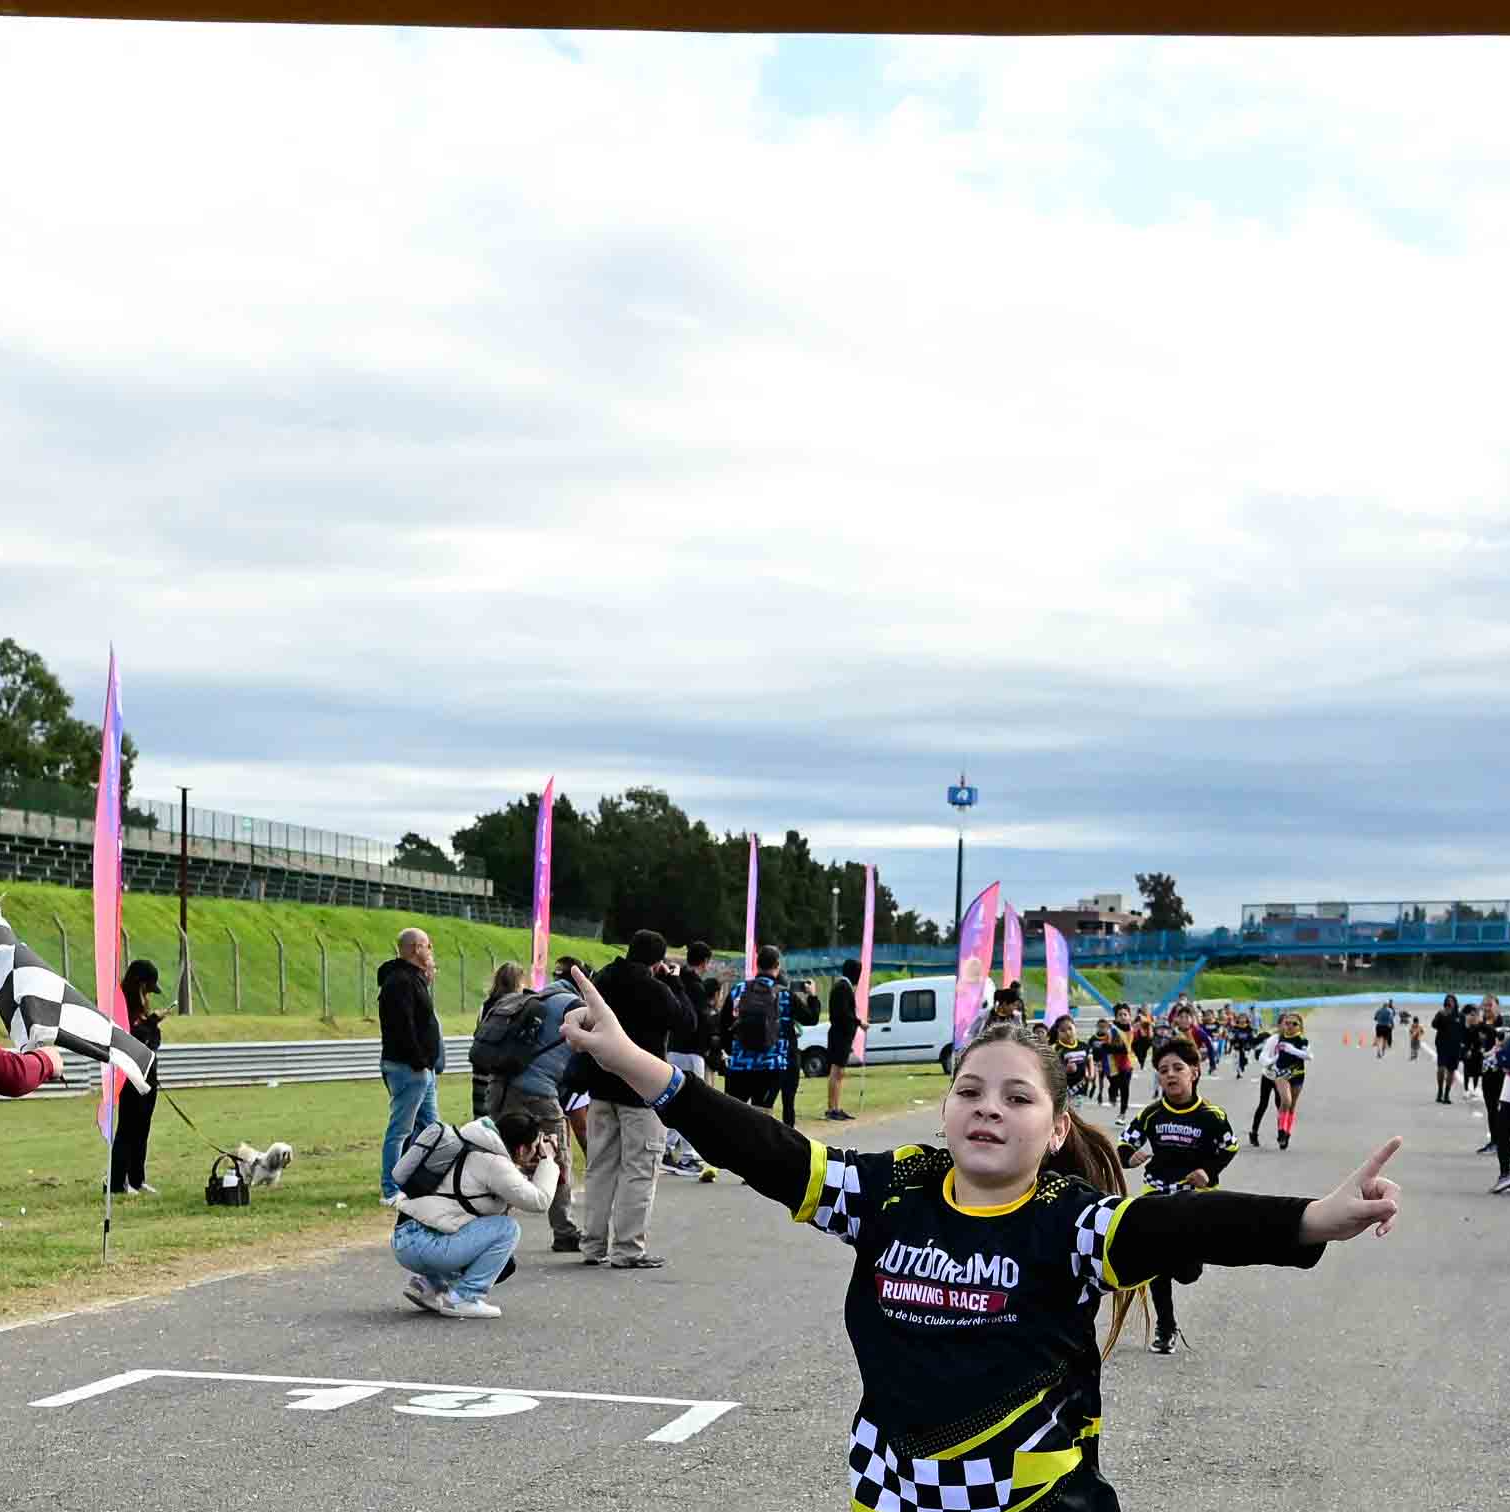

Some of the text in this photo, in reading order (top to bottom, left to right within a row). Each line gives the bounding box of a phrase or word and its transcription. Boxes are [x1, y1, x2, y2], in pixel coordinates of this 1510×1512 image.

[882, 1279, 991, 1312] RUNNING RACE
[895, 1309, 908, 1320] de
[909, 1311, 922, 1324] los
[924, 1314, 955, 1326] Clubes
